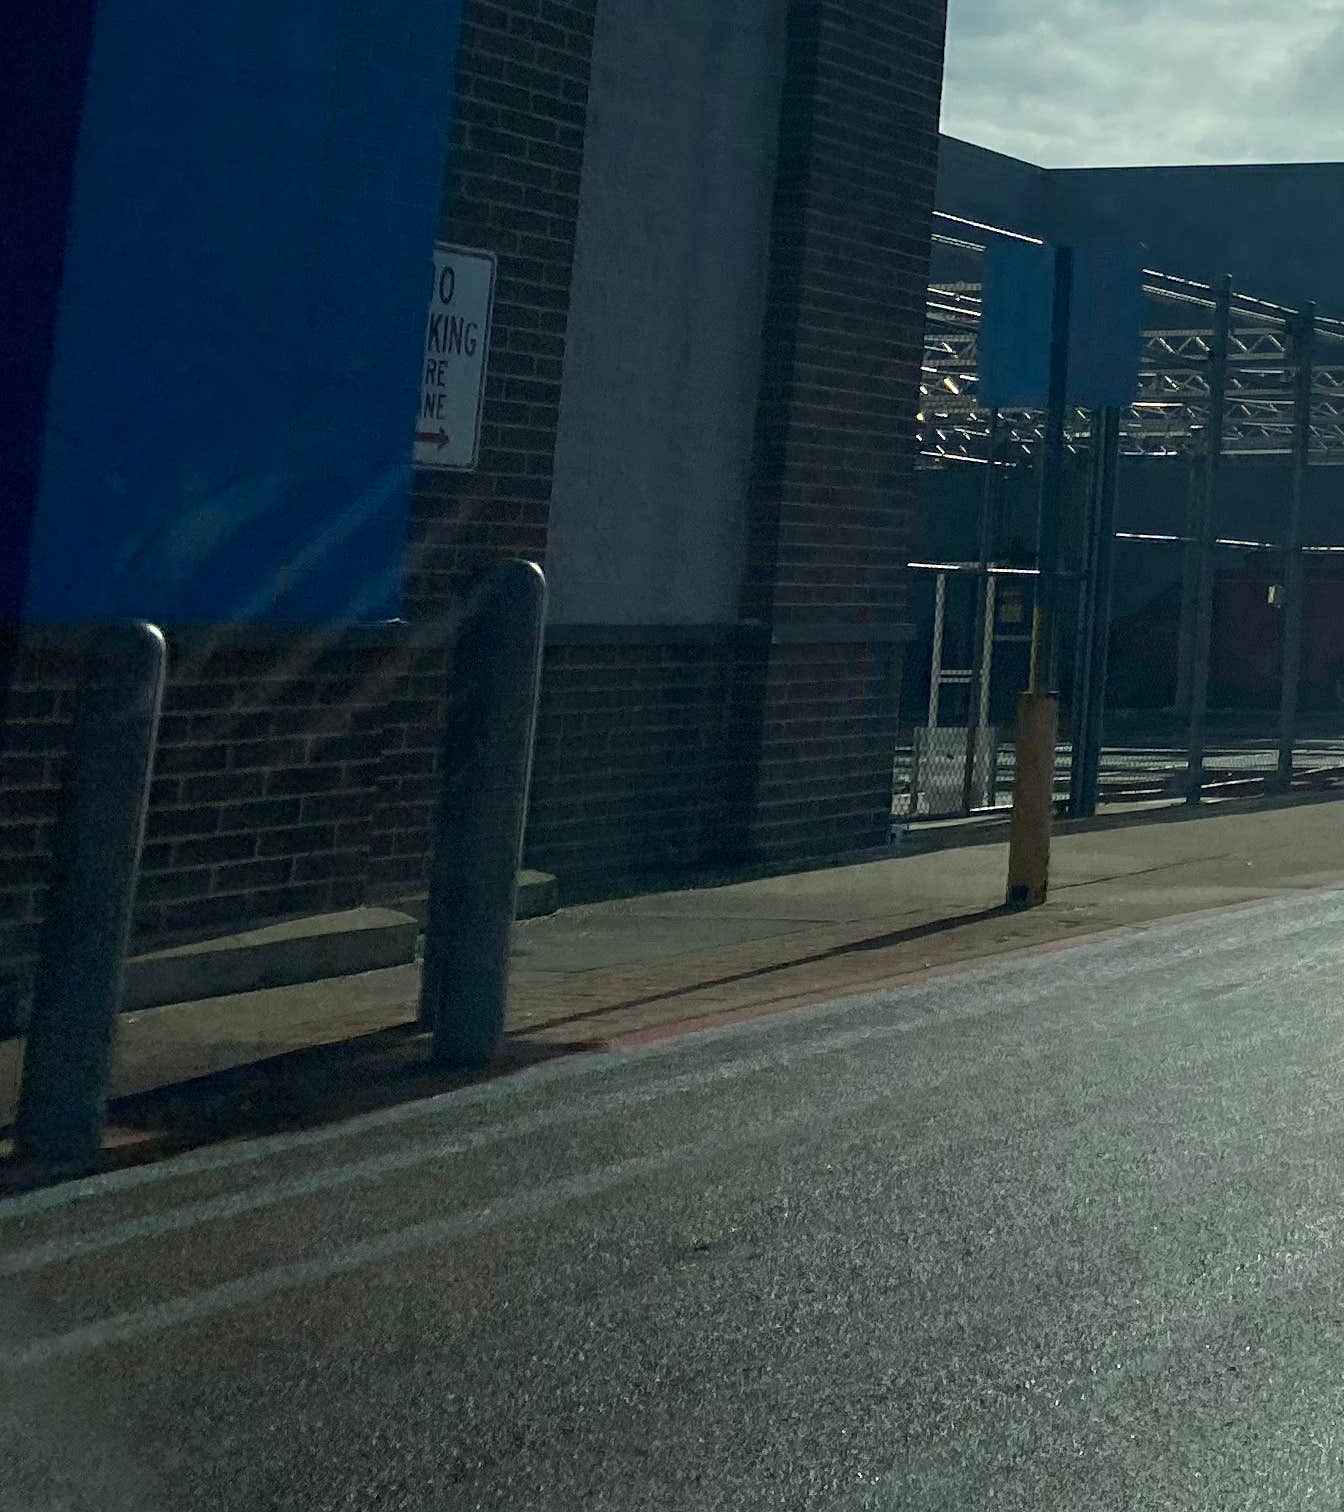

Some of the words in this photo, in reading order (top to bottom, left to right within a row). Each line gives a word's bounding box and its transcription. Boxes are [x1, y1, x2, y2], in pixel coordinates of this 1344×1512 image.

[426, 314, 477, 356] KING
[424, 359, 448, 387] RE
[422, 393, 447, 419] NE
